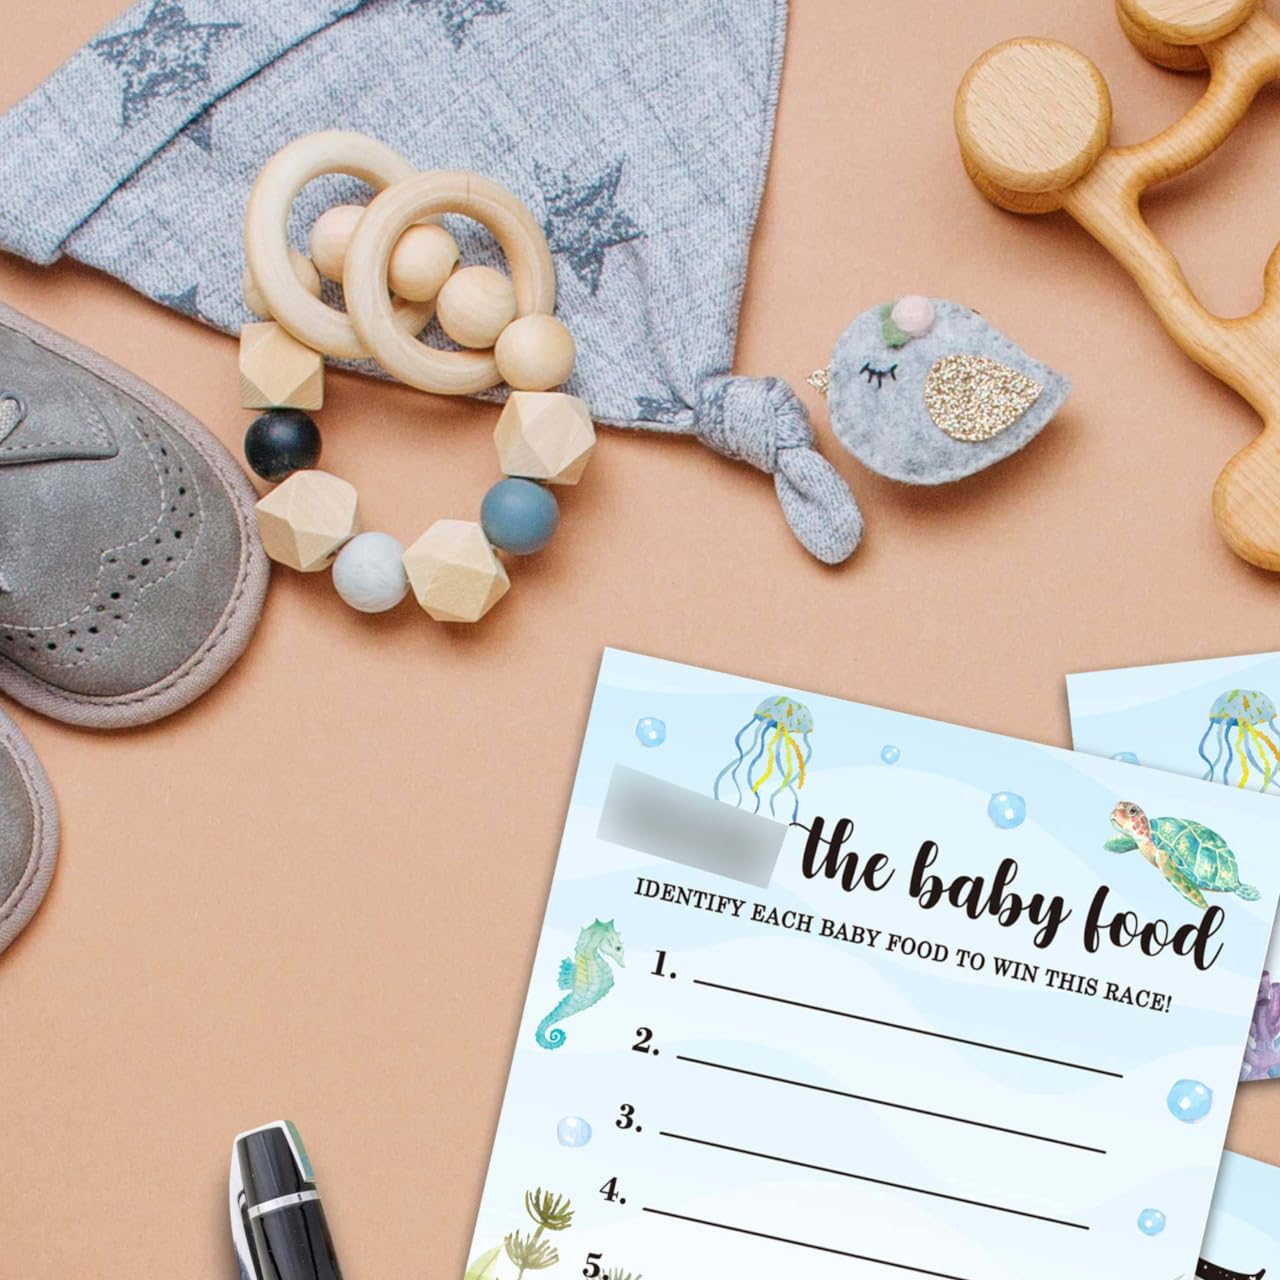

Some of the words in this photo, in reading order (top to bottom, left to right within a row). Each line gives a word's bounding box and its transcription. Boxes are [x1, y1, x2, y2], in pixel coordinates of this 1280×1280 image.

[789, 816, 896, 894] the
[909, 840, 1073, 949] baby
[1083, 885, 1225, 971] food
[633, 876, 746, 919] IDENTIFY
[750, 903, 815, 936] EACH
[819, 917, 882, 946] BABY
[886, 932, 949, 963] FOOD
[955, 948, 986, 972] TO
[993, 957, 1040, 985] WIN
[1045, 968, 1099, 1000] THIS
[1101, 981, 1173, 1014] RACE!
[650, 949, 677, 980] 1.
[631, 1026, 660, 1056] 2.
[614, 1103, 643, 1132] 3.
[598, 1176, 627, 1203] 4.
[582, 1252, 610, 1280] 5.
